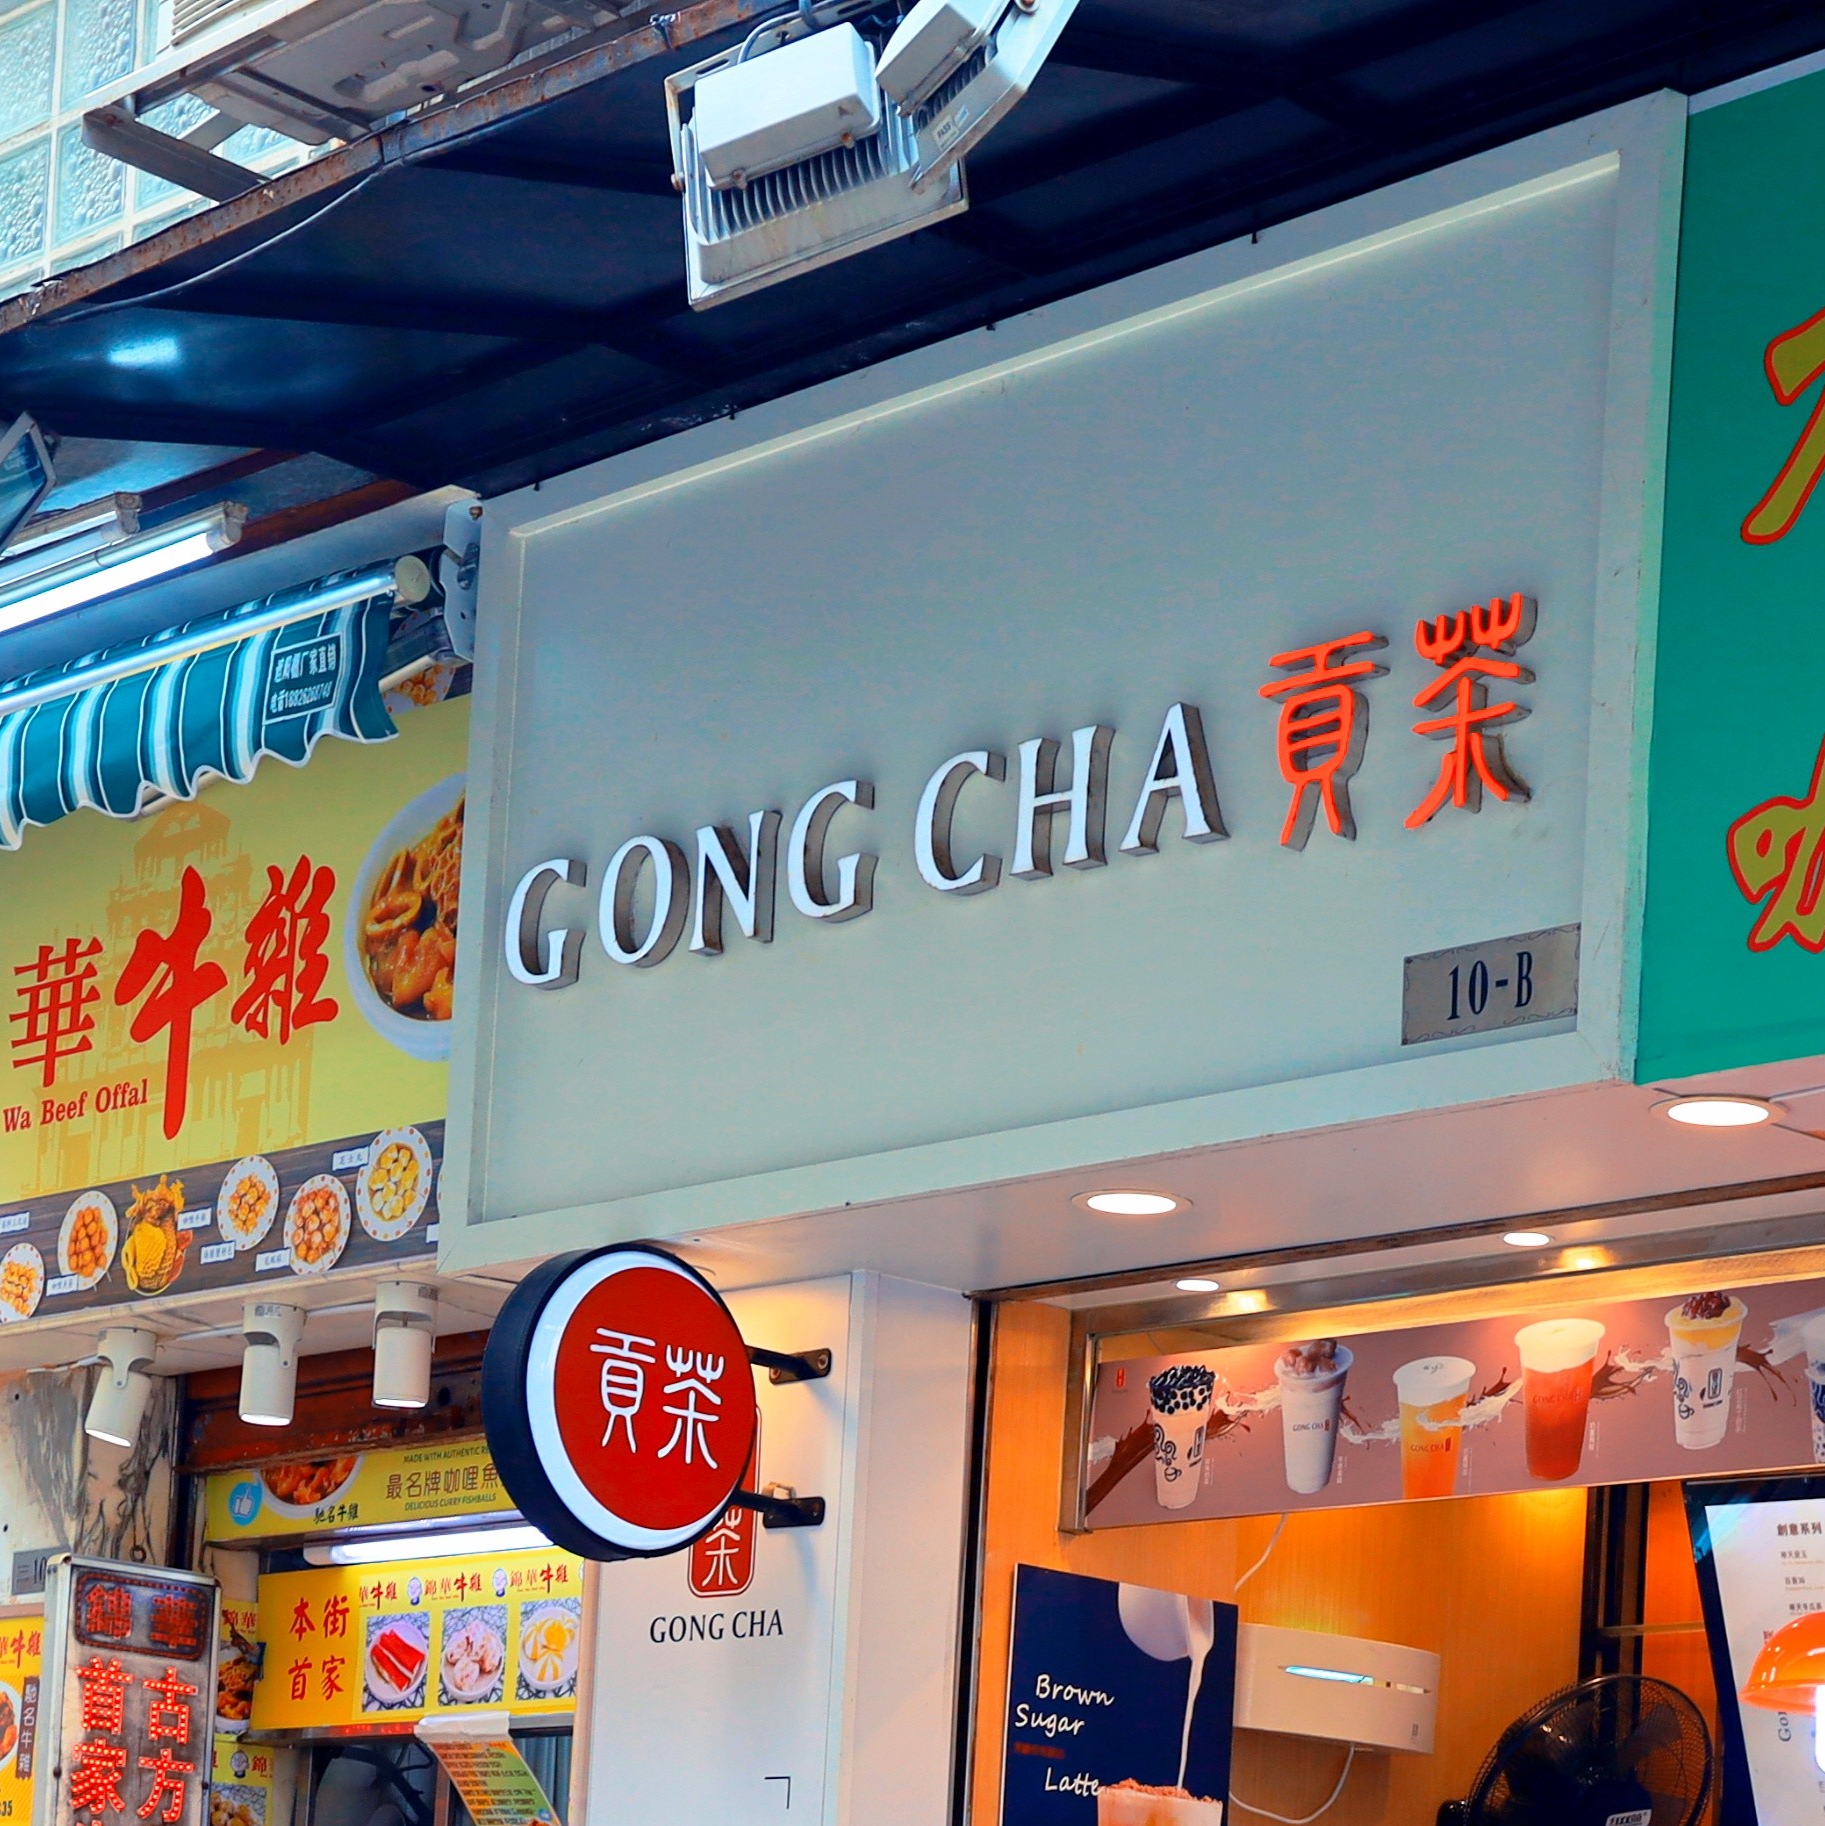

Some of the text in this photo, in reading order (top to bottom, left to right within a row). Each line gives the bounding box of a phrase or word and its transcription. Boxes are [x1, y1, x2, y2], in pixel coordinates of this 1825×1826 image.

[1259, 591, 1534, 846] 貢茶
[504, 701, 1229, 990] GONG CHA
[1444, 950, 1535, 1024] 10-B
[3, 1106, 32, 1133] Wa
[41, 1093, 87, 1125] Beef
[94, 1078, 148, 1112] Offal
[589, 1328, 726, 1469] 貢茶
[404, 1452, 424, 1463] MADE
[425, 1450, 443, 1461] WITH
[443, 1446, 481, 1459] AUTHENTIC
[386, 1464, 504, 1500] 最名牌咖哩魚
[404, 1492, 496, 1512] DELICIOUS CURRY FISHBALLS
[288, 1595, 350, 1641] 本街
[650, 1608, 783, 1643] GONG CHA
[287, 1655, 345, 1700] 首家
[1036, 1674, 1114, 1706] Brown
[1015, 1703, 1085, 1737] Sugar
[1045, 1768, 1102, 1796] Latte
